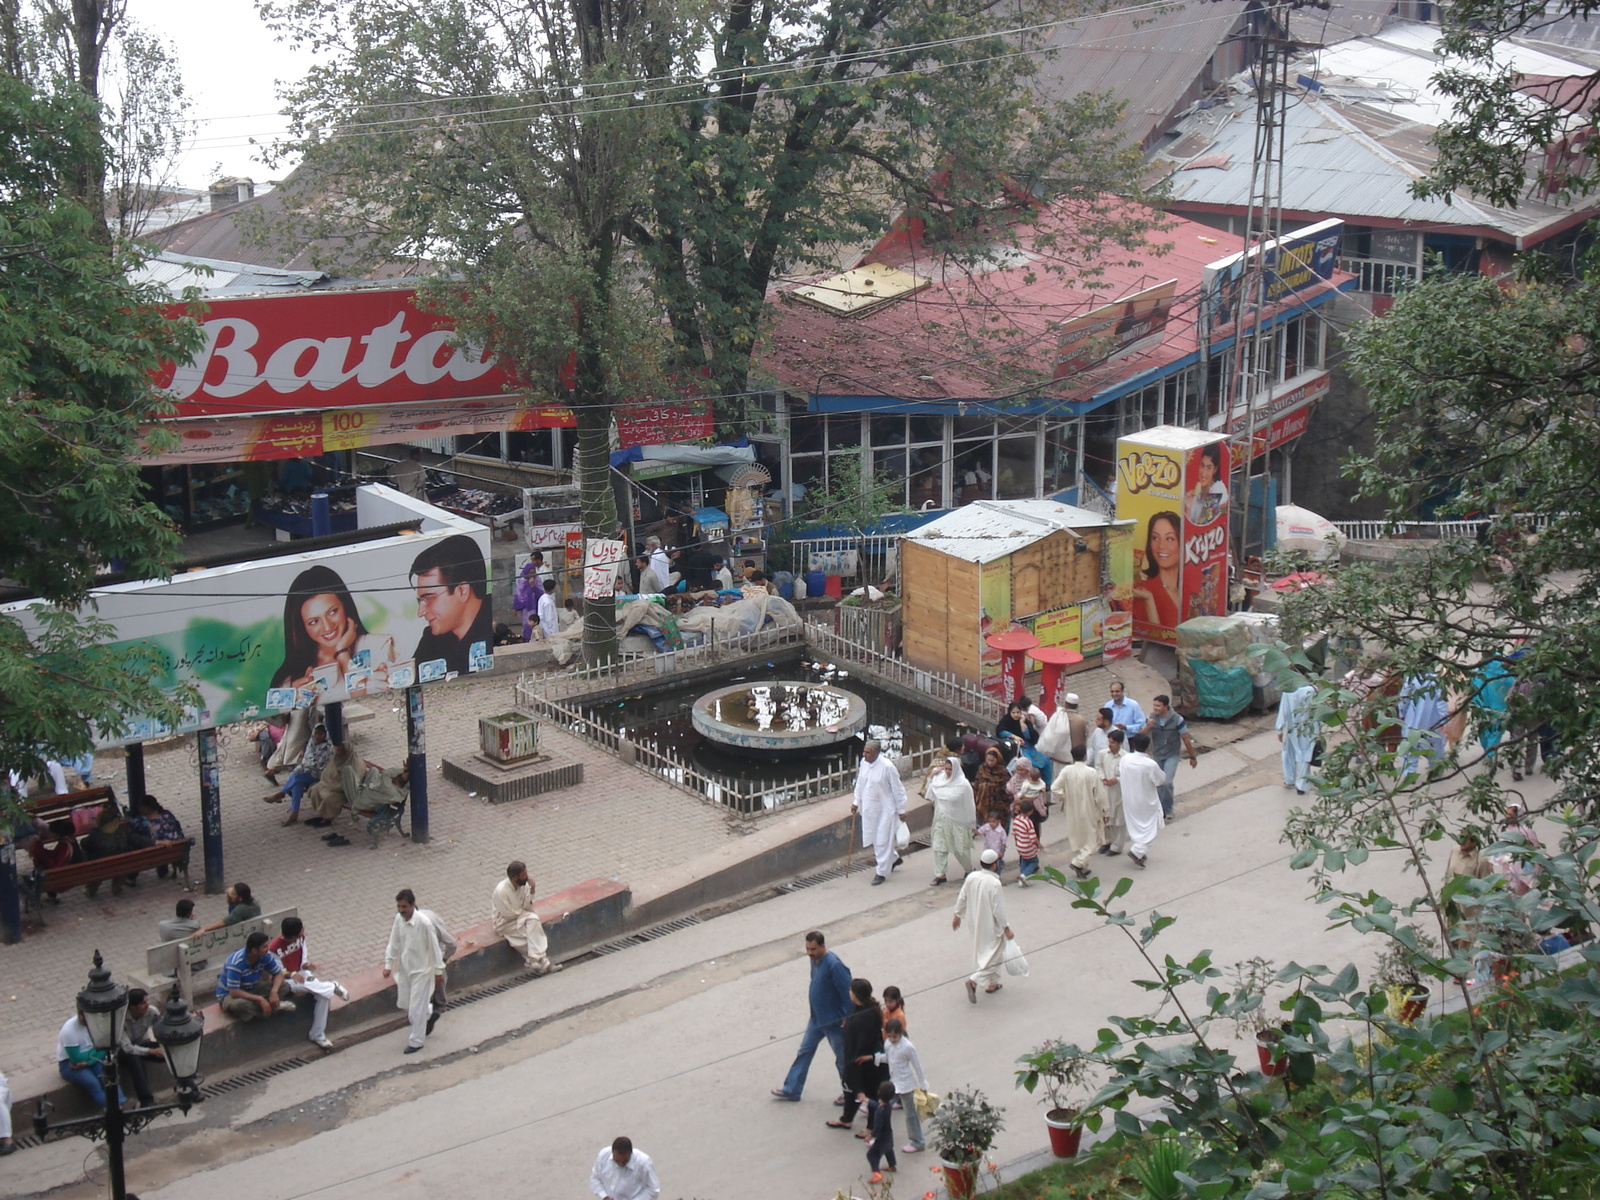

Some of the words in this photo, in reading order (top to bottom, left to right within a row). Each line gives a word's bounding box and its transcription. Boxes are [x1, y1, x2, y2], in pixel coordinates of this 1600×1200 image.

[157, 310, 497, 400] Bata
[331, 411, 363, 432] 100
[592, 542, 619, 562] چاول
